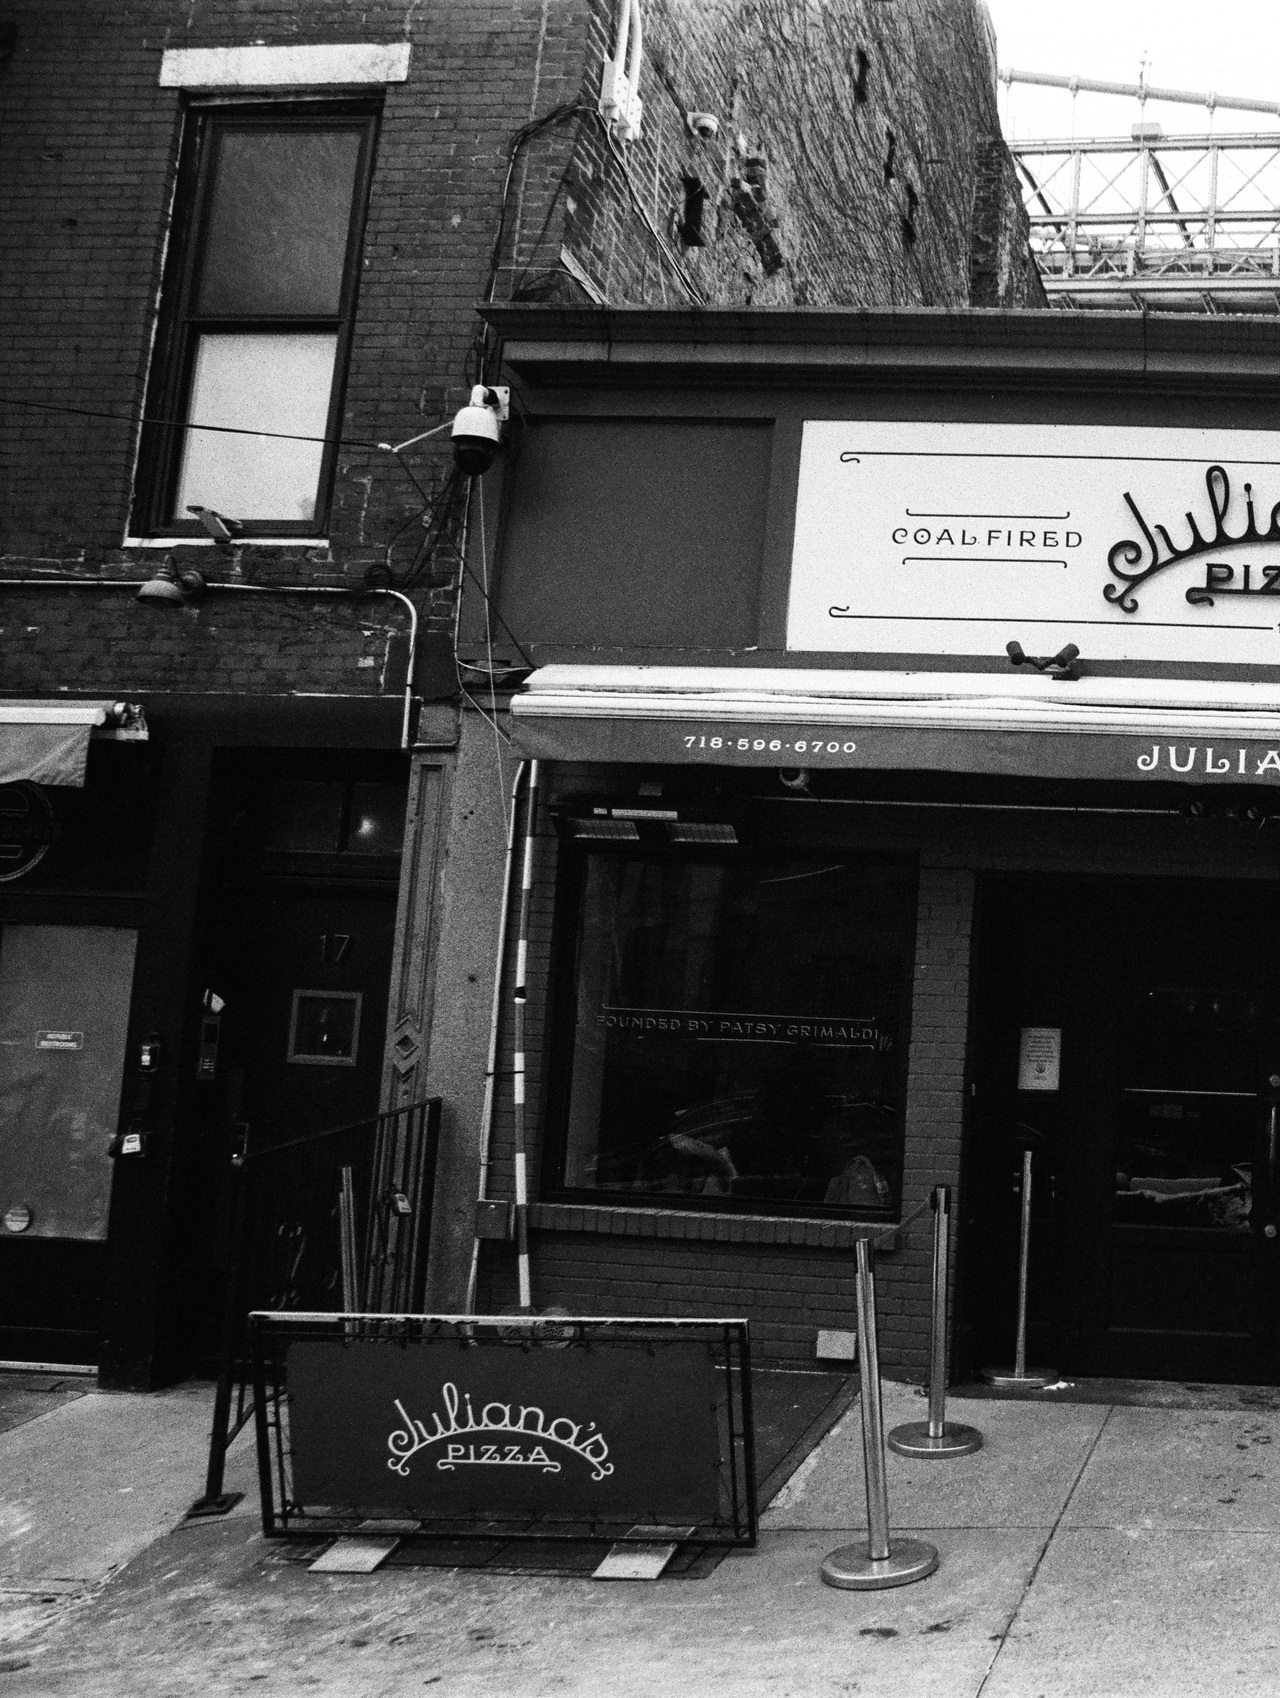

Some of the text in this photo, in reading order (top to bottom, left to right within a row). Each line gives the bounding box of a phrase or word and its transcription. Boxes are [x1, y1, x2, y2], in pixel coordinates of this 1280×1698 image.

[892, 527, 1083, 548] COAL FIRED
[319, 934, 350, 962] 17
[596, 1014, 879, 1041] FOUNDED BY PATSY GRIMALDI
[387, 1382, 610, 1463] Juliana's
[446, 1443, 553, 1464] PIZZA
